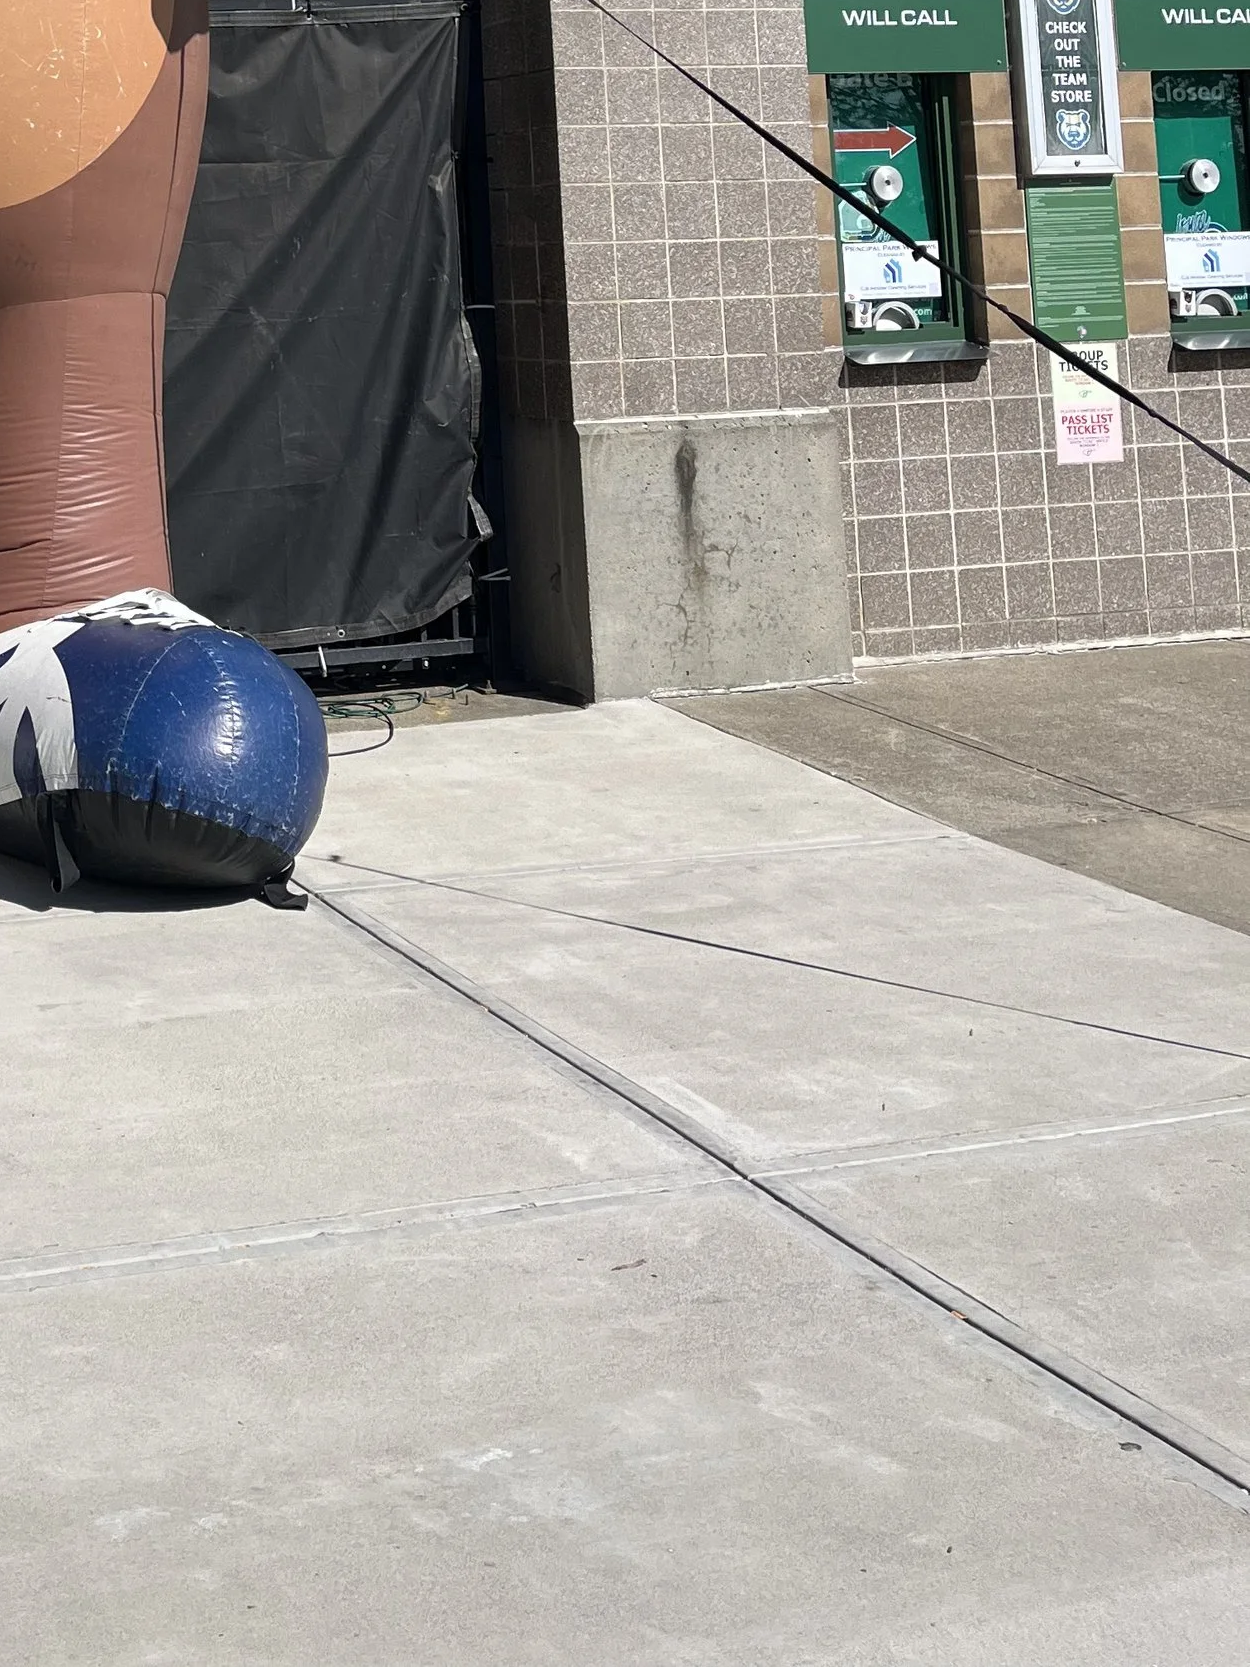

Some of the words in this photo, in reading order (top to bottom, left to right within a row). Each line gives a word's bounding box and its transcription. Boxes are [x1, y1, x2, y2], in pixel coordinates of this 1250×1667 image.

[842, 10, 898, 26] WILL
[901, 10, 958, 25] CALL
[1161, 8, 1213, 24] WILL
[1045, 21, 1087, 34] CHECK
[1054, 38, 1080, 51] OUT
[1056, 55, 1081, 68] THE
[1053, 73, 1087, 86] TEAM
[1051, 90, 1092, 103] STORE
[1153, 80, 1226, 102] Closed
[1062, 415, 1087, 425] PASS
[1091, 414, 1113, 423] LIST
[1067, 424, 1110, 435] TICKETS
